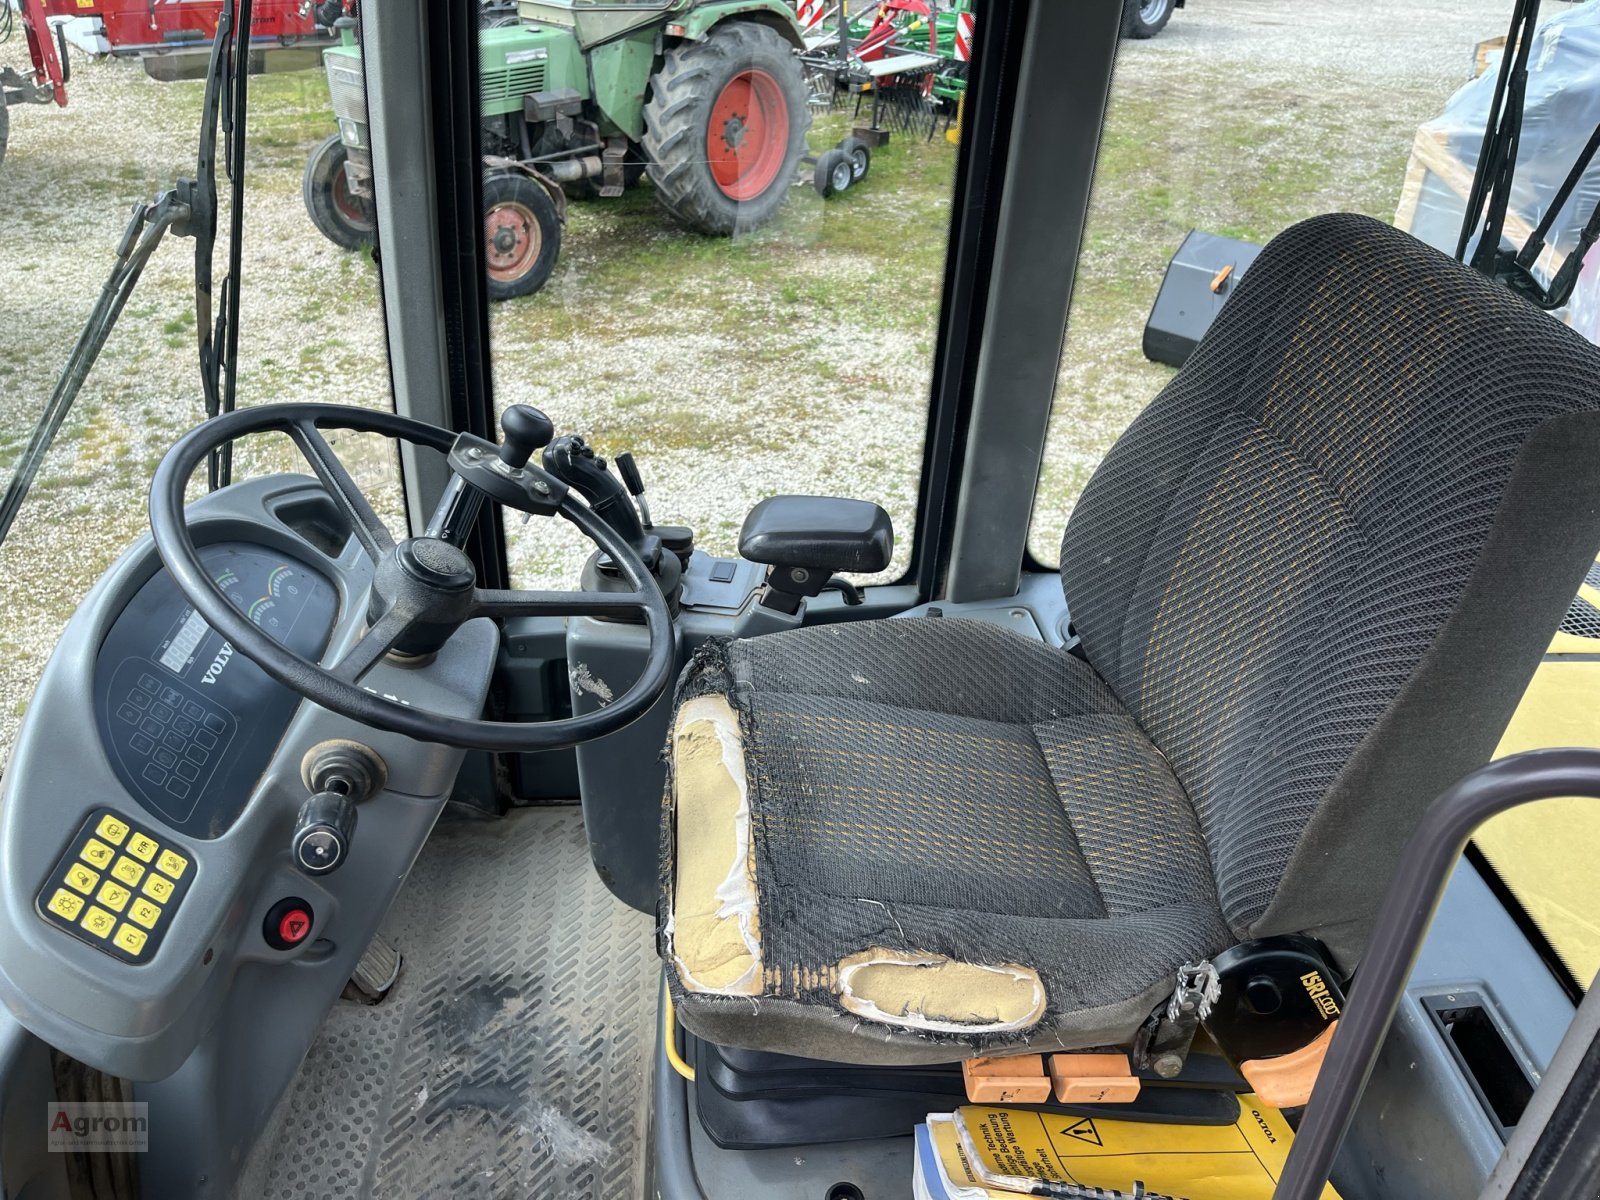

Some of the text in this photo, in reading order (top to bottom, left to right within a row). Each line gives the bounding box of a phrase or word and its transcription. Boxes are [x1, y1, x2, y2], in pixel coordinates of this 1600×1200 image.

[201, 641, 234, 685] VOLV
[137, 840, 150, 855] F/R
[153, 882, 165, 894] F3
[140, 907, 151, 919] F2
[126, 934, 137, 945] F1
[1300, 970, 1330, 1000] ISRI
[980, 1123, 997, 1152] Technik
[988, 1113, 1010, 1154] Bedienung
[999, 1112, 1017, 1144] Wartung
[1252, 1110, 1277, 1144] VOLVO
